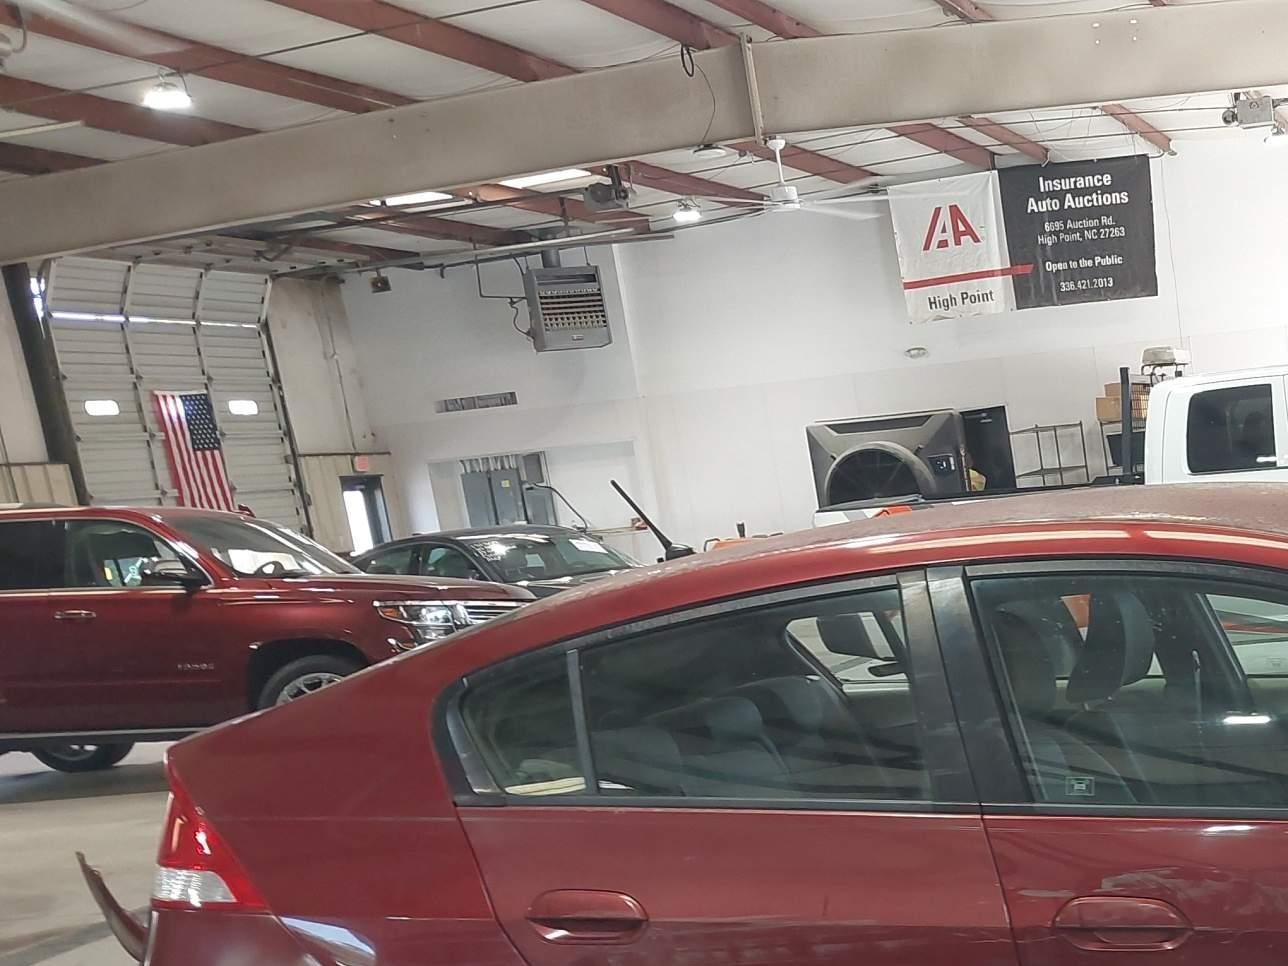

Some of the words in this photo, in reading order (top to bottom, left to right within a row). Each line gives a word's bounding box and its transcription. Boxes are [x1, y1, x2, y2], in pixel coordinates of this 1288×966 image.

[1038, 173, 1113, 193] Insurance
[1026, 197, 1060, 214] Auto
[1063, 190, 1129, 210] Auctions
[1044, 221, 1065, 233] 6695
[1066, 217, 1100, 230] Auction
[1101, 215, 1117, 227] Rd.
[1037, 232, 1058, 246] High
[1059, 231, 1083, 243] Point,
[1084, 228, 1099, 241] NC
[1100, 226, 1126, 239] 27263
[1045, 260, 1068, 273] Open
[1069, 259, 1078, 269] to
[1079, 256, 1093, 269] the
[1094, 254, 1123, 267] Public
[1059, 276, 1114, 292] 336.421.2013
[928, 293, 958, 312] High
[960, 289, 996, 306] Point
